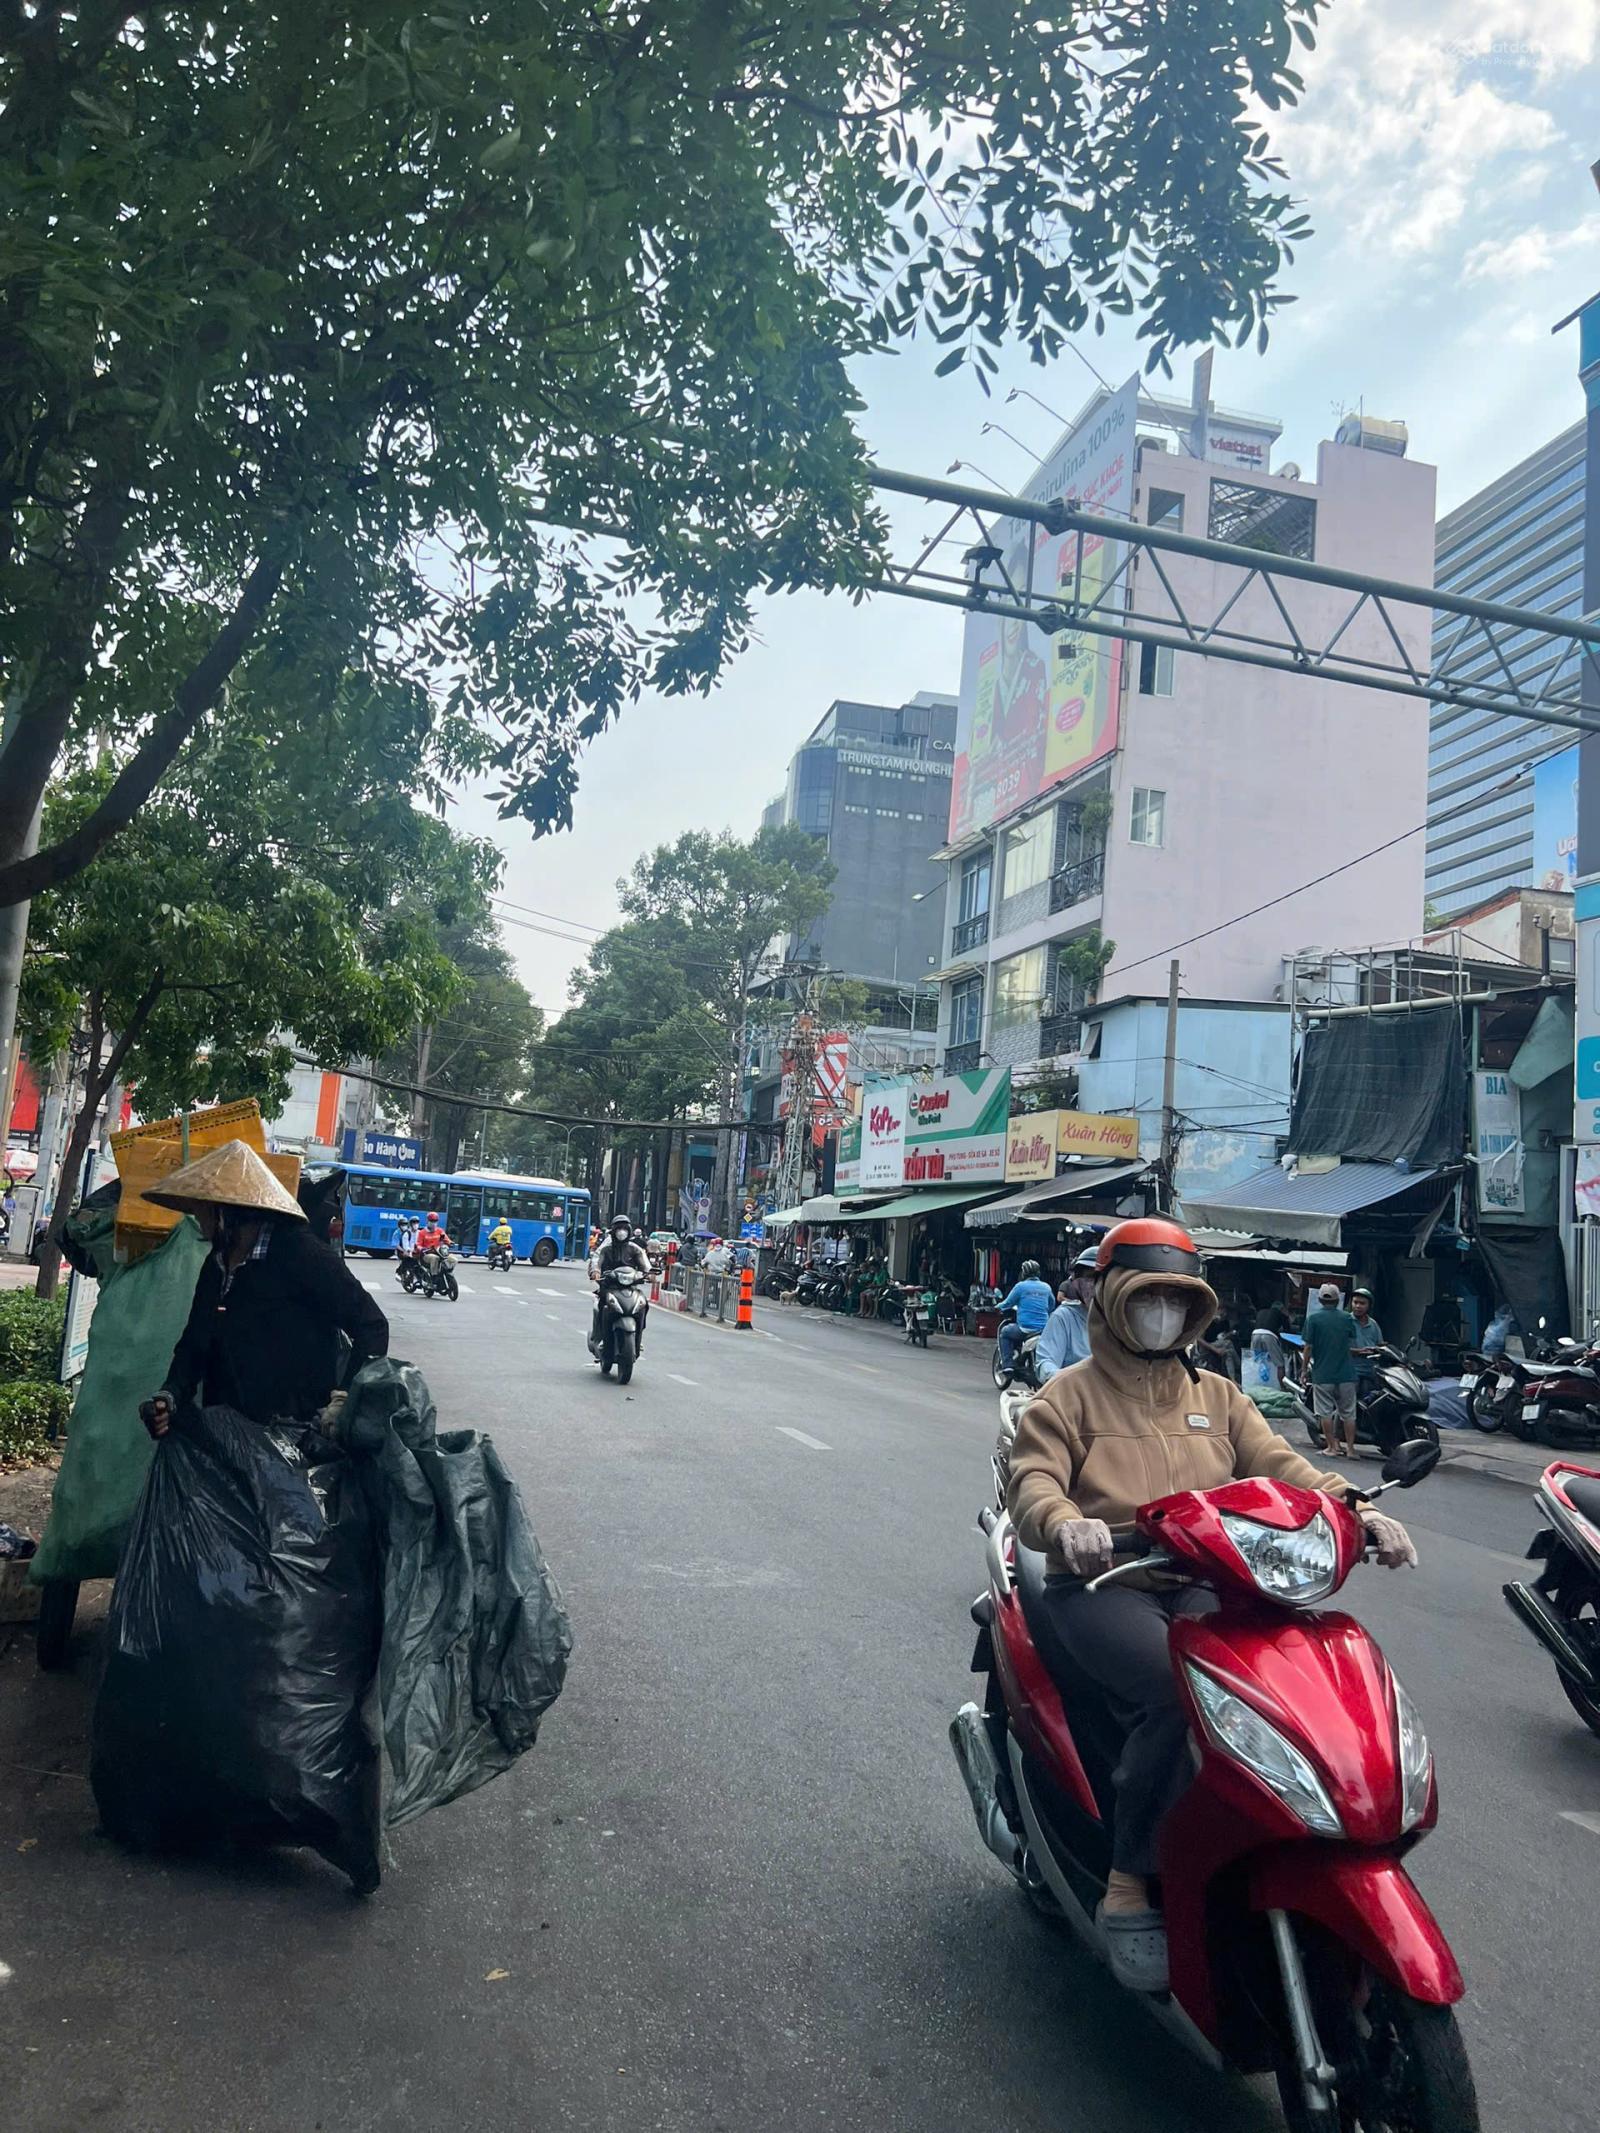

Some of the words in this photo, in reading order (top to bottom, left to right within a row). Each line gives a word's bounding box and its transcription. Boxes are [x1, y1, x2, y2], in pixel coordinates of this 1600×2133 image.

[1088, 403, 1125, 457] 100%
[842, 751, 878, 767] TRUNG
[1486, 1076, 1507, 1095] BIA
[919, 1089, 949, 1112] Castrol
[1063, 1122, 1096, 1141] Xuân
[1099, 1126, 1133, 1149] Hồng
